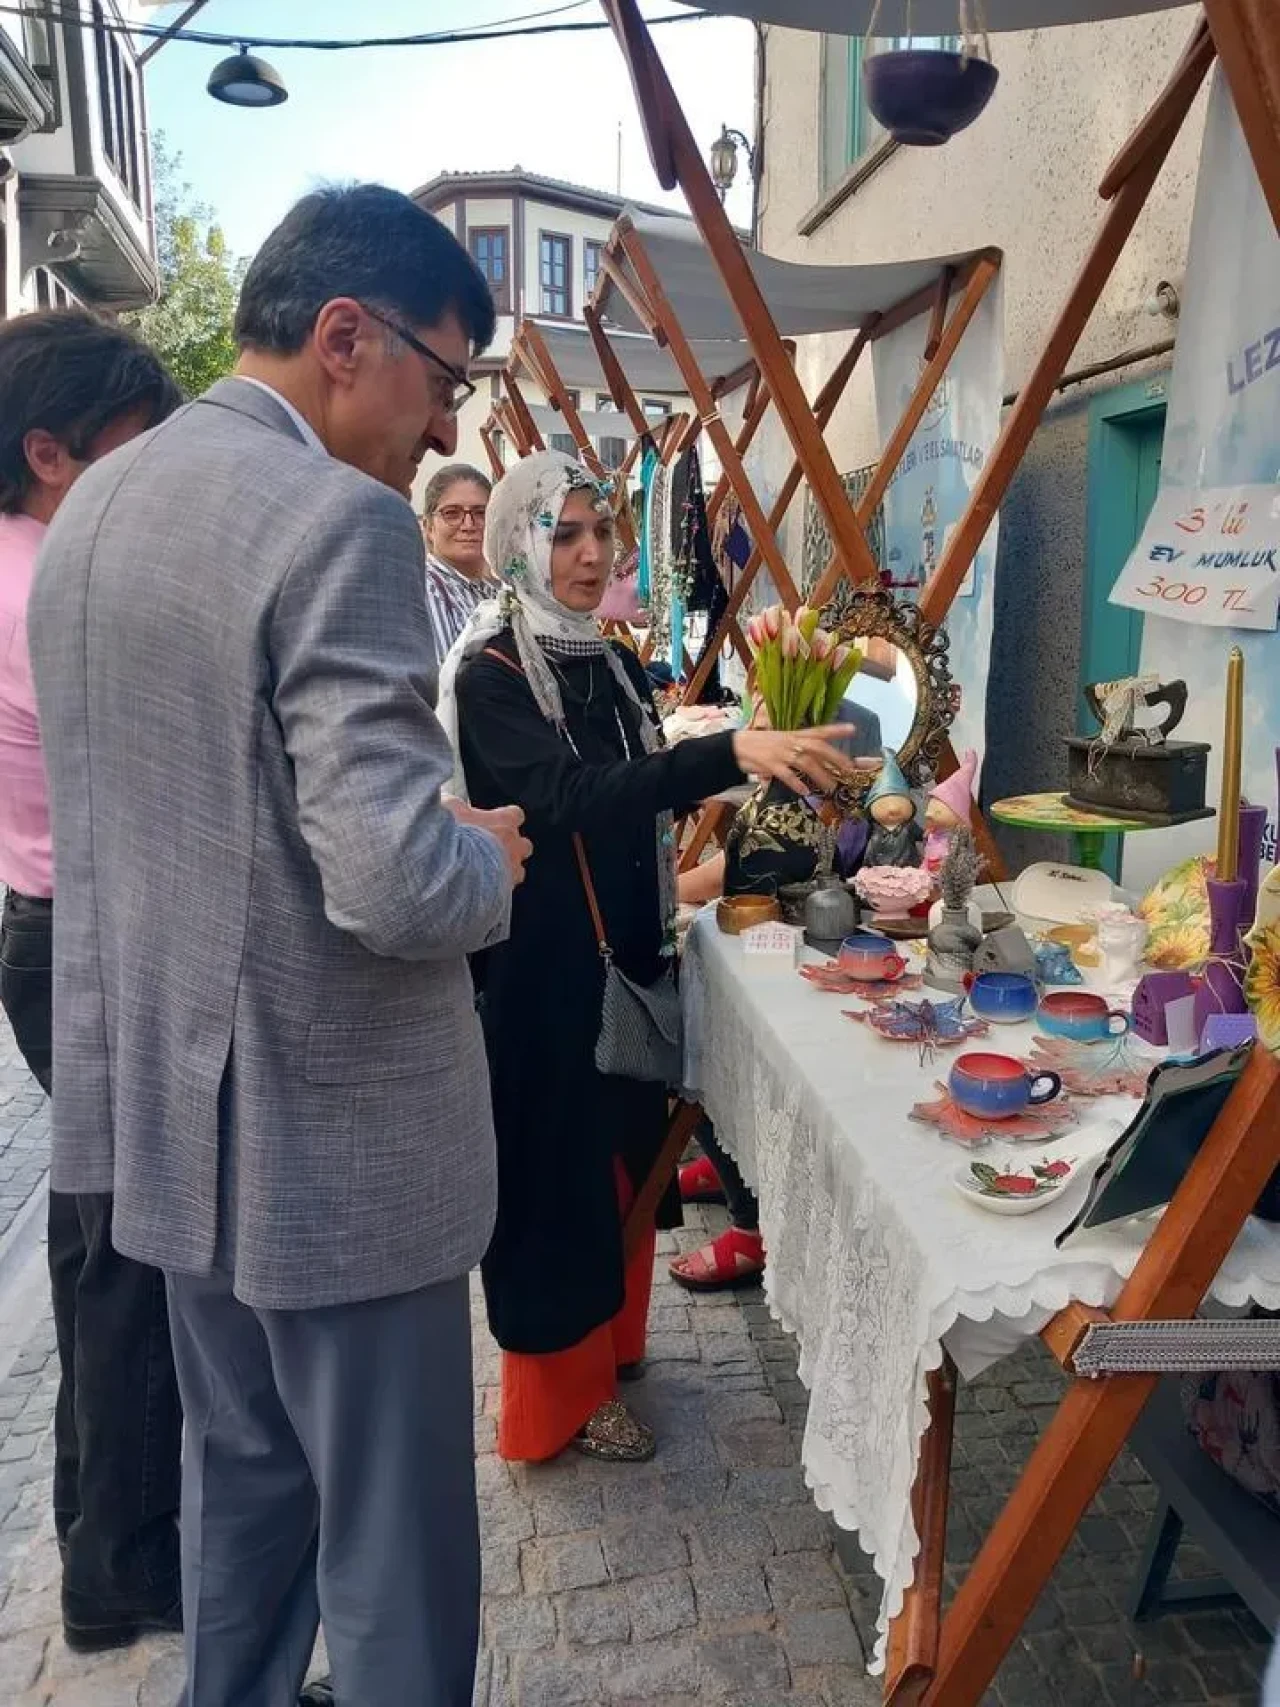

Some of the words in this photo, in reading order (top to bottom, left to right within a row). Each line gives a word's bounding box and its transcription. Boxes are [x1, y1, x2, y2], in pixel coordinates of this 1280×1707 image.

[1149, 545, 1185, 563] EV
[1197, 548, 1277, 572] MUMLUK
[1136, 576, 1208, 605] 300
[1223, 586, 1256, 612] TL
